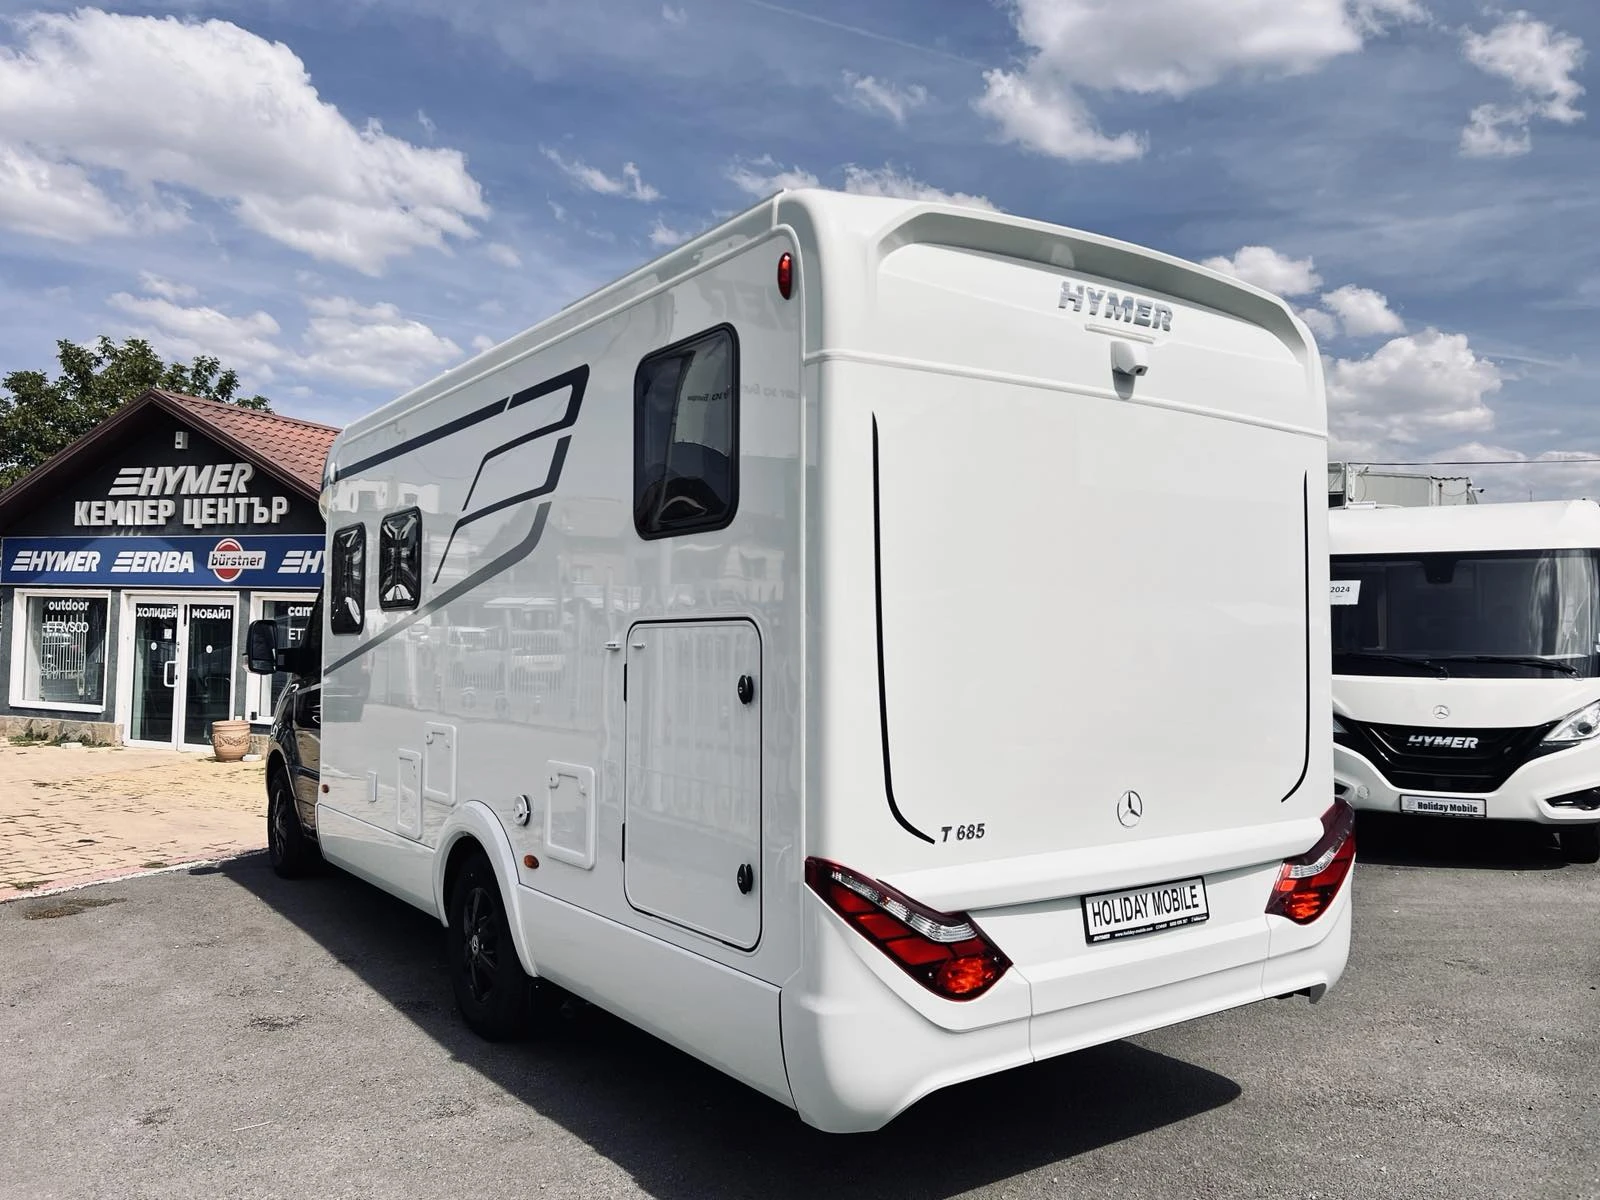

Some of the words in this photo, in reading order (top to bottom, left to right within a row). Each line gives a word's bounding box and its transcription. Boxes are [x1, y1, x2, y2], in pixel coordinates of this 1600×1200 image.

[1058, 281, 1174, 332] HYMER
[138, 463, 253, 496] HYMER
[74, 499, 175, 526] КЕМПЕР
[182, 496, 289, 529] ЦЕНТЪР
[28, 551, 101, 572] HYMER
[130, 551, 195, 573] ERIBA
[211, 553, 262, 566] bürstner
[48, 599, 90, 611] outdoor
[137, 606, 178, 618] ХОЛИДЕЙ
[192, 608, 232, 619] МОБАЙЛ
[1406, 735, 1479, 749] HYMER
[1417, 802, 1449, 812] Holiday
[1449, 803, 1478, 813] Mobile
[941, 826, 952, 842] T
[957, 823, 985, 840] 685
[1091, 893, 1149, 928] HOLIDAY
[1152, 885, 1199, 916] MOBILE
